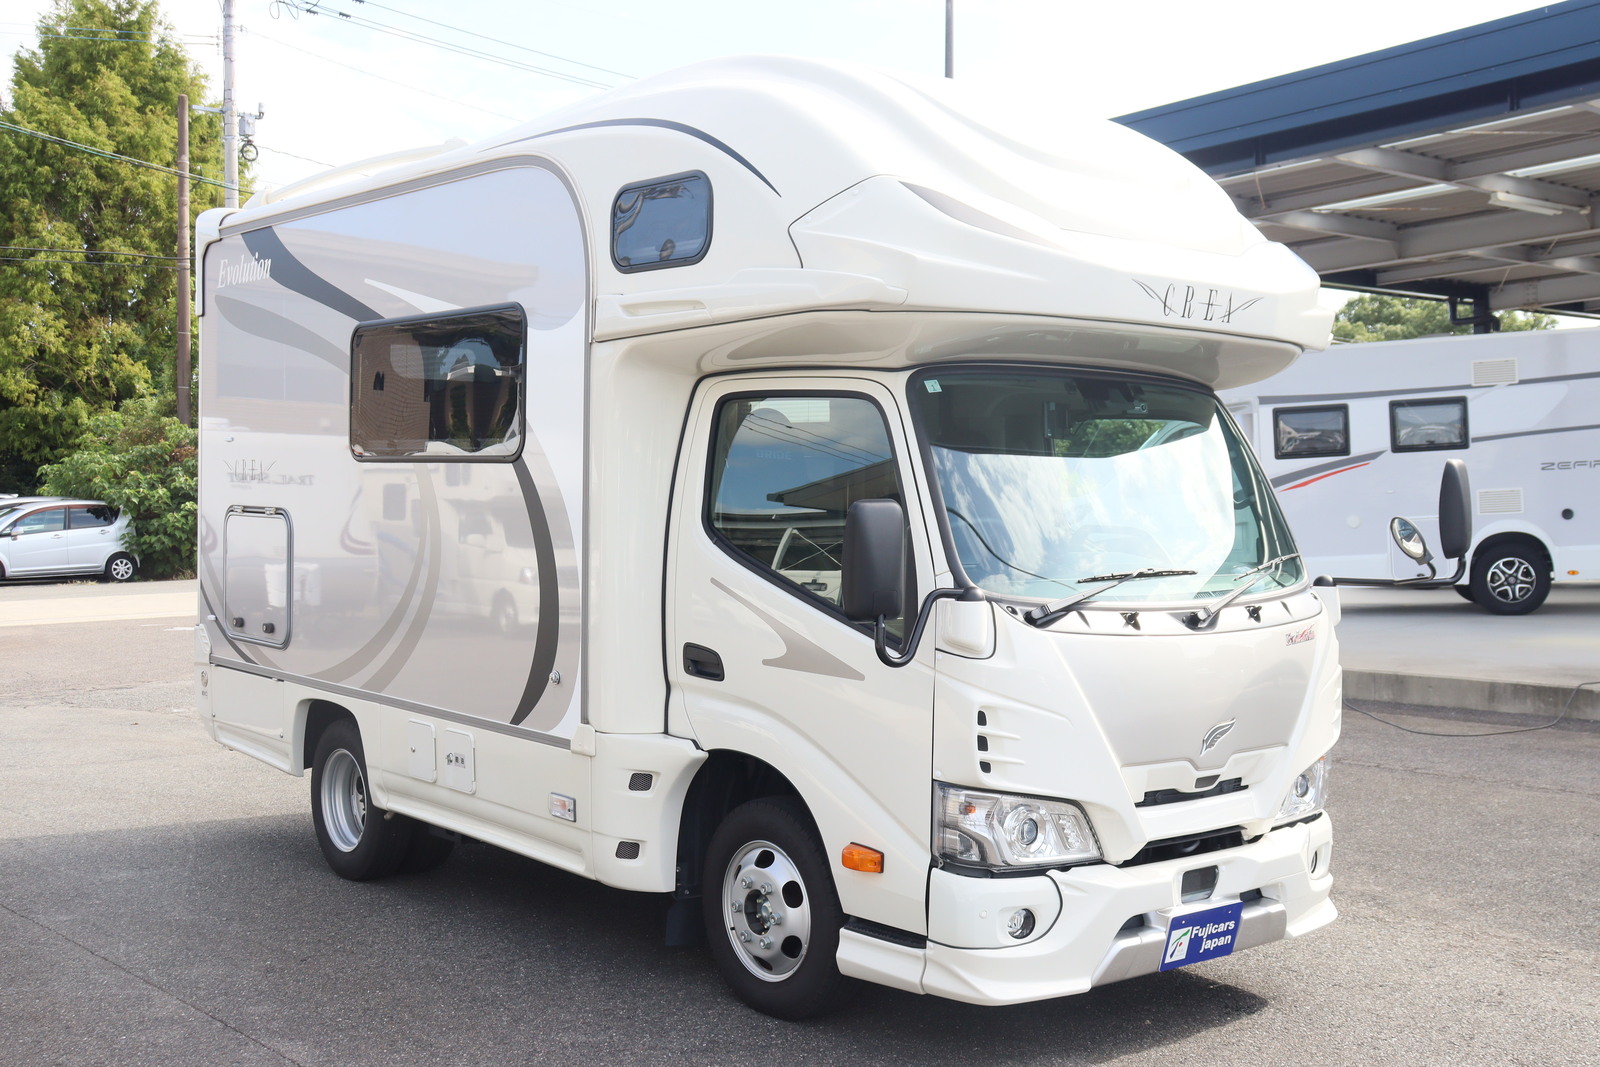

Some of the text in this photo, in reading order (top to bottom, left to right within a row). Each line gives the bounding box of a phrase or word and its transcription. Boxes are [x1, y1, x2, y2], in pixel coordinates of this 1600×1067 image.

[217, 251, 272, 289] Evolution
[1191, 920, 1236, 939] Fujicars
[1199, 934, 1232, 954] japan
